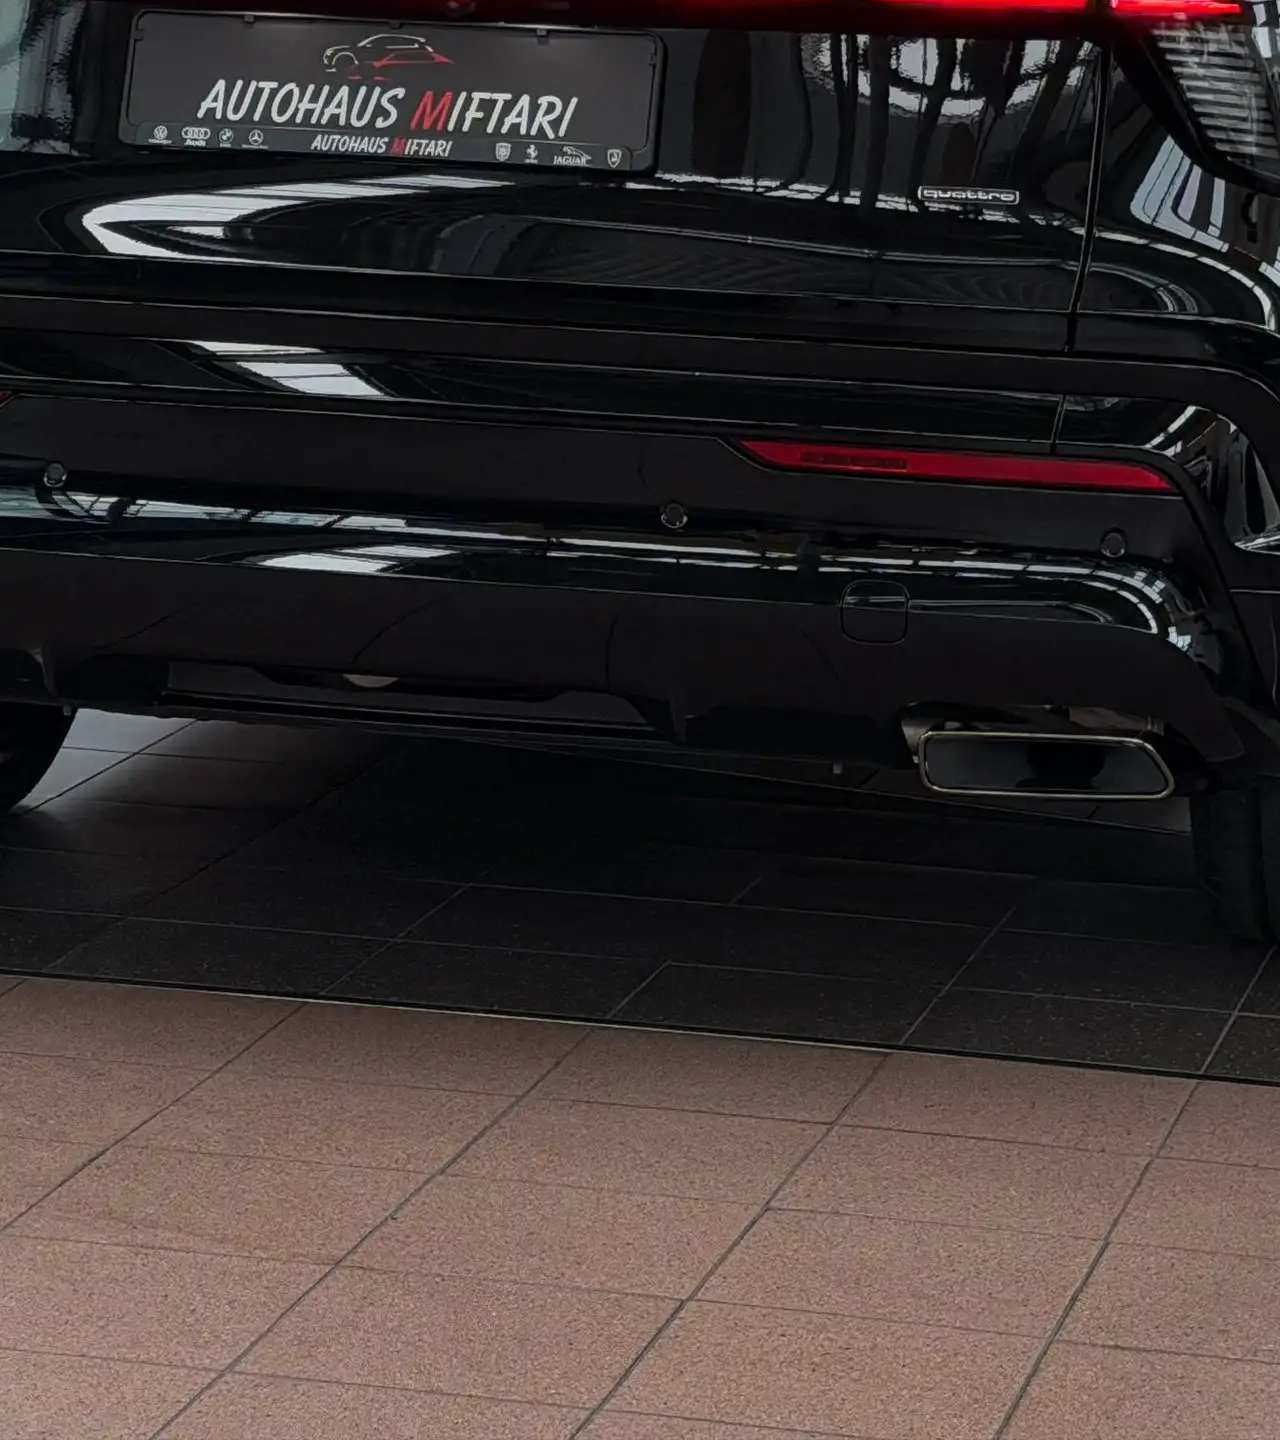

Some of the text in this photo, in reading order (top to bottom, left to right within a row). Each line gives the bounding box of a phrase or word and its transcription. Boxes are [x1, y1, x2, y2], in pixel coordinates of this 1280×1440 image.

[197, 79, 578, 139] AUTOHAUS MIFTARI
[311, 134, 452, 157] AUTOHAUS MIFTARI
[553, 156, 586, 165] JAGUAR
[923, 189, 1015, 201] quattro
